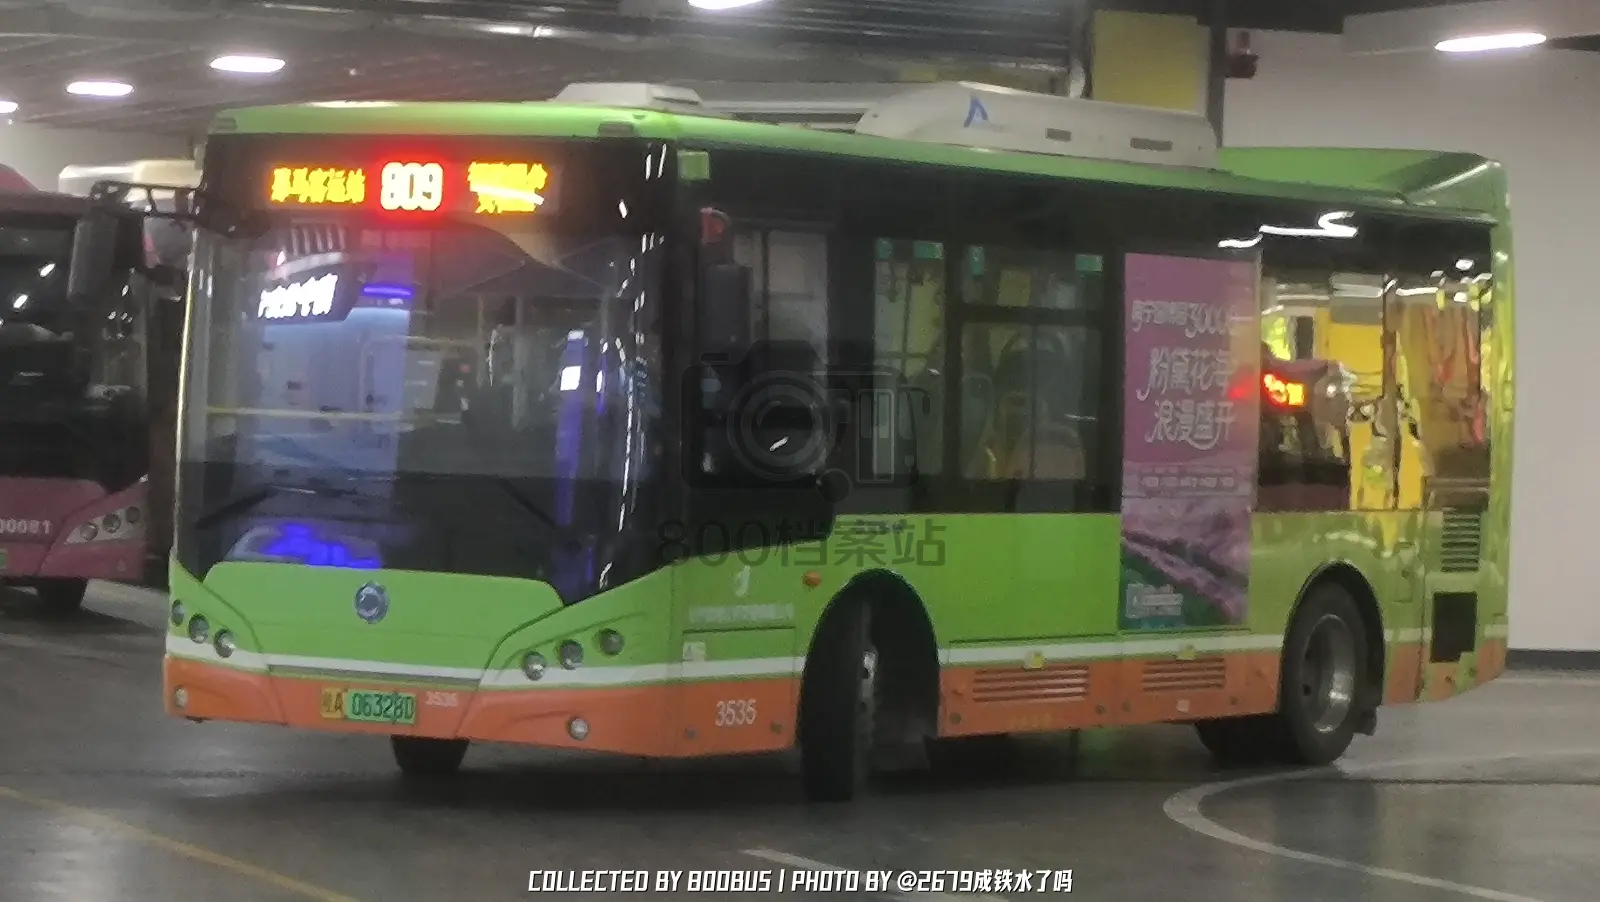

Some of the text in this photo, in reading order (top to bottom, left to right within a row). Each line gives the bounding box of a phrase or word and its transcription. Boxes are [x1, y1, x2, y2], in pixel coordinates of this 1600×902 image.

[381, 162, 443, 210] 809
[1144, 399, 1237, 450] 浪漫盛开
[714, 699, 757, 727] 3535
